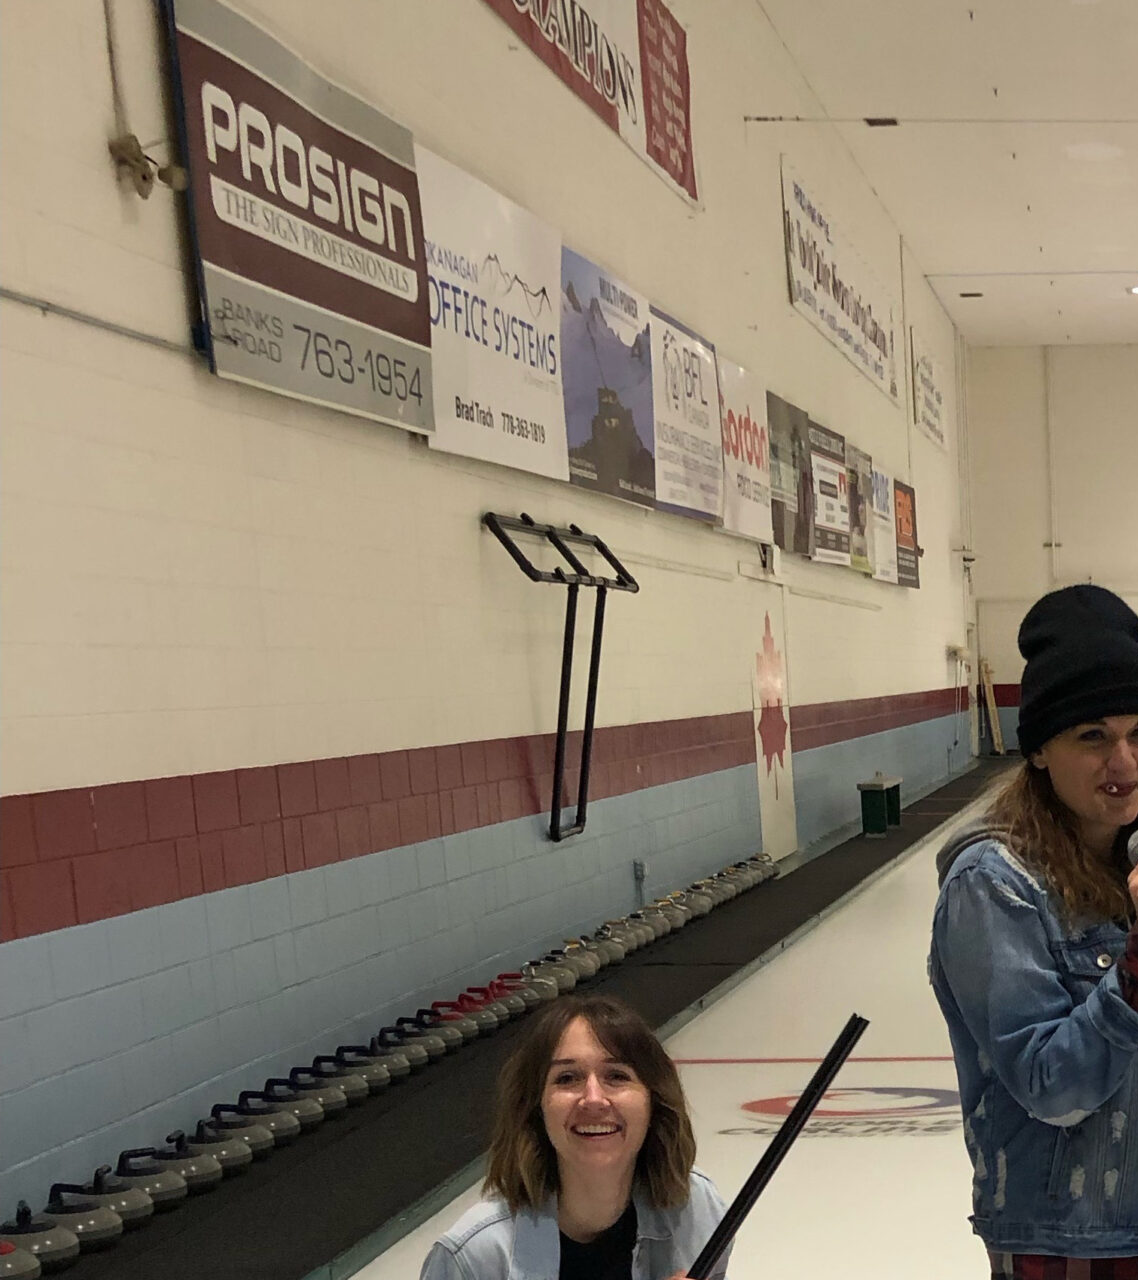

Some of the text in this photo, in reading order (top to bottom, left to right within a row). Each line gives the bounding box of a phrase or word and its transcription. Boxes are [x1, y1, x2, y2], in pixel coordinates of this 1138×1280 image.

[221, 187, 410, 293] THE SIGN PROFESSIONALS
[222, 297, 283, 338] BANKS
[429, 275, 556, 375] OFFICE SYSTEMS
[293, 324, 422, 406] 763-1954
[683, 347, 708, 406] BFL
[455, 396, 474, 422] Brad
